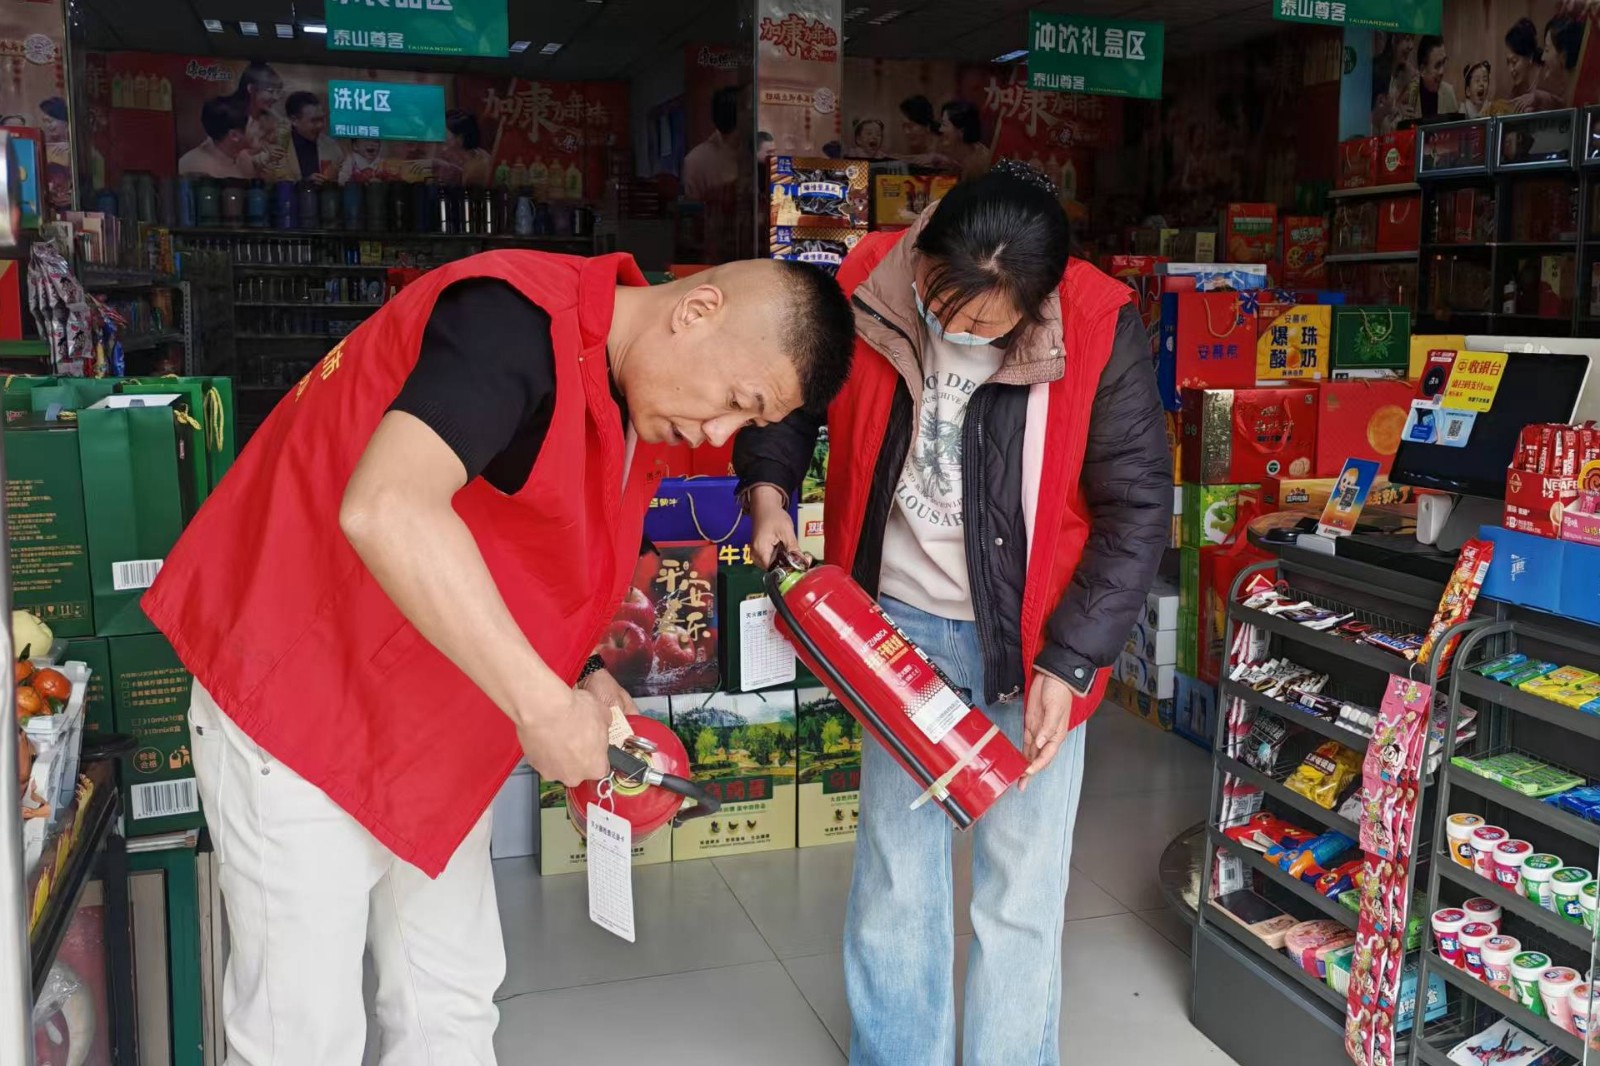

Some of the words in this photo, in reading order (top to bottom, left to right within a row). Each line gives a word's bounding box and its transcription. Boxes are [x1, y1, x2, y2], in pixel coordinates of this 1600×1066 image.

[1281, 0, 1346, 22] 泰山尊客
[333, 29, 404, 49] 泰山尊客
[1035, 21, 1147, 61] 冲饮礼盒区
[1033, 72, 1085, 91] 泰山尊客
[334, 87, 391, 112] 洗化区
[335, 124, 380, 137] 泰山尊客
